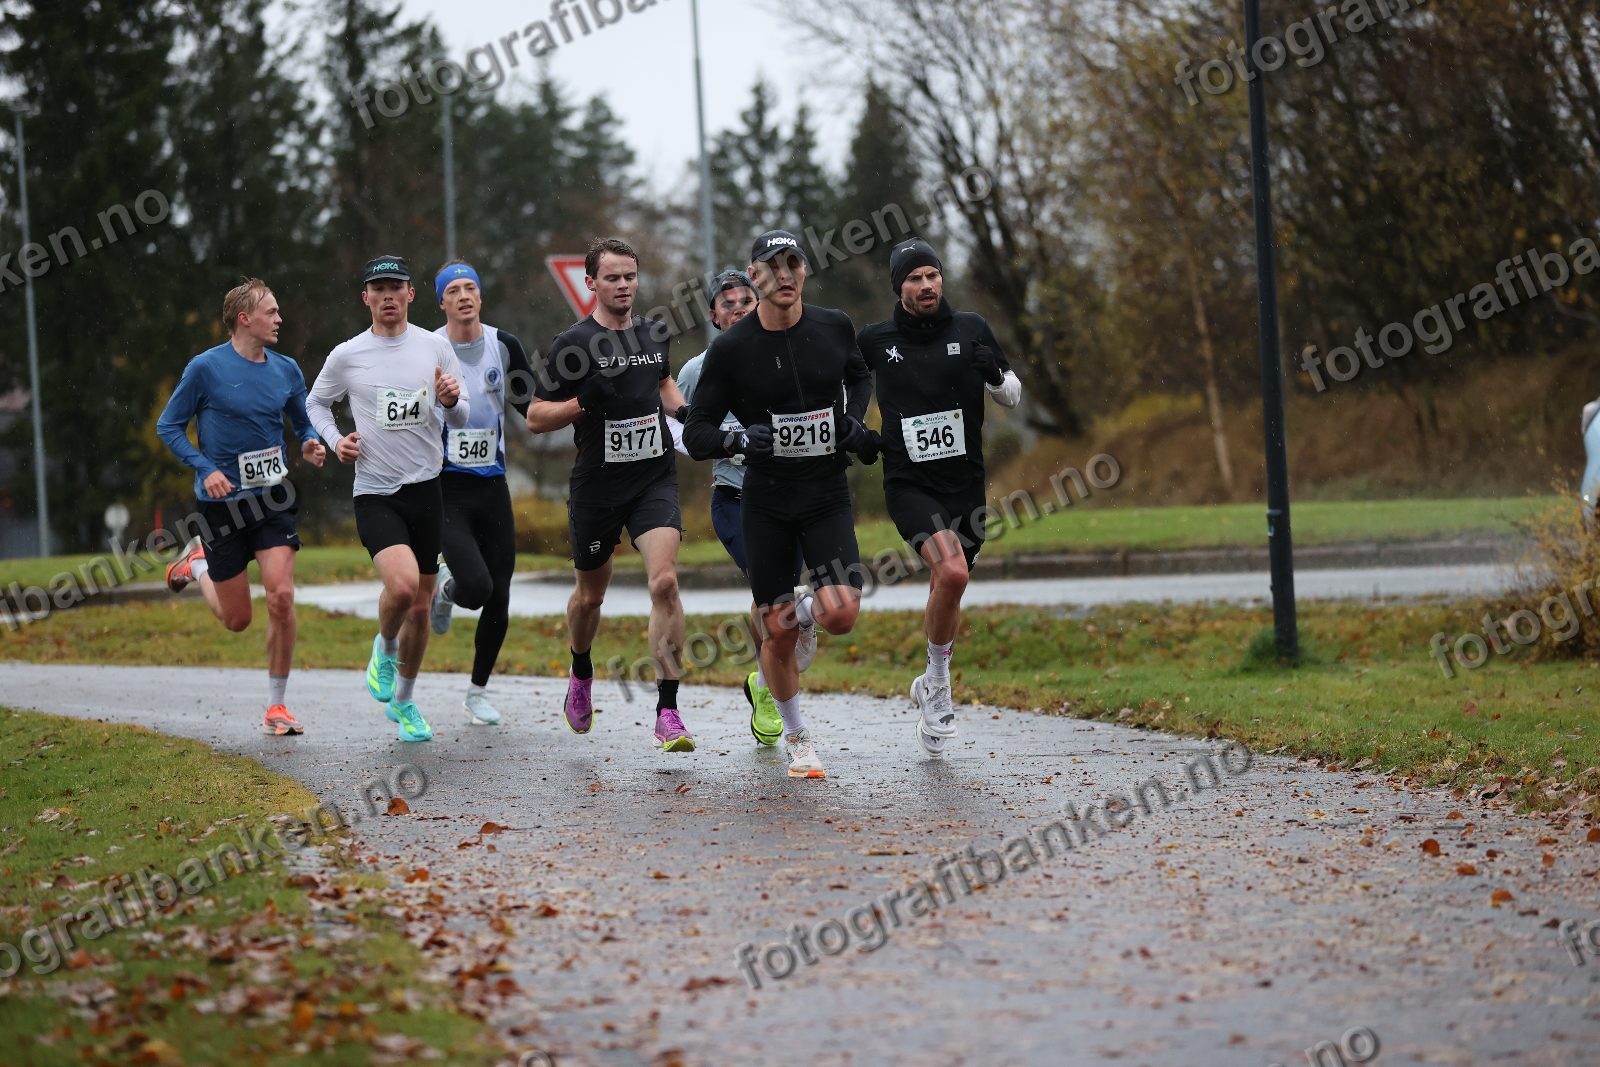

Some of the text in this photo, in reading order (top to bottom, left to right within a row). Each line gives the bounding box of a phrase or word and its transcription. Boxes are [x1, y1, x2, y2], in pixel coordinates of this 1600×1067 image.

[767, 237, 798, 248] HOKA
[373, 262, 399, 273] HOKA
[387, 401, 420, 421] 614
[778, 411, 831, 424] NORGESTESTER
[610, 425, 657, 452] 9177
[779, 421, 831, 447] 9218
[916, 424, 955, 452] 546
[458, 440, 489, 459] 548
[244, 457, 282, 480] 9478
